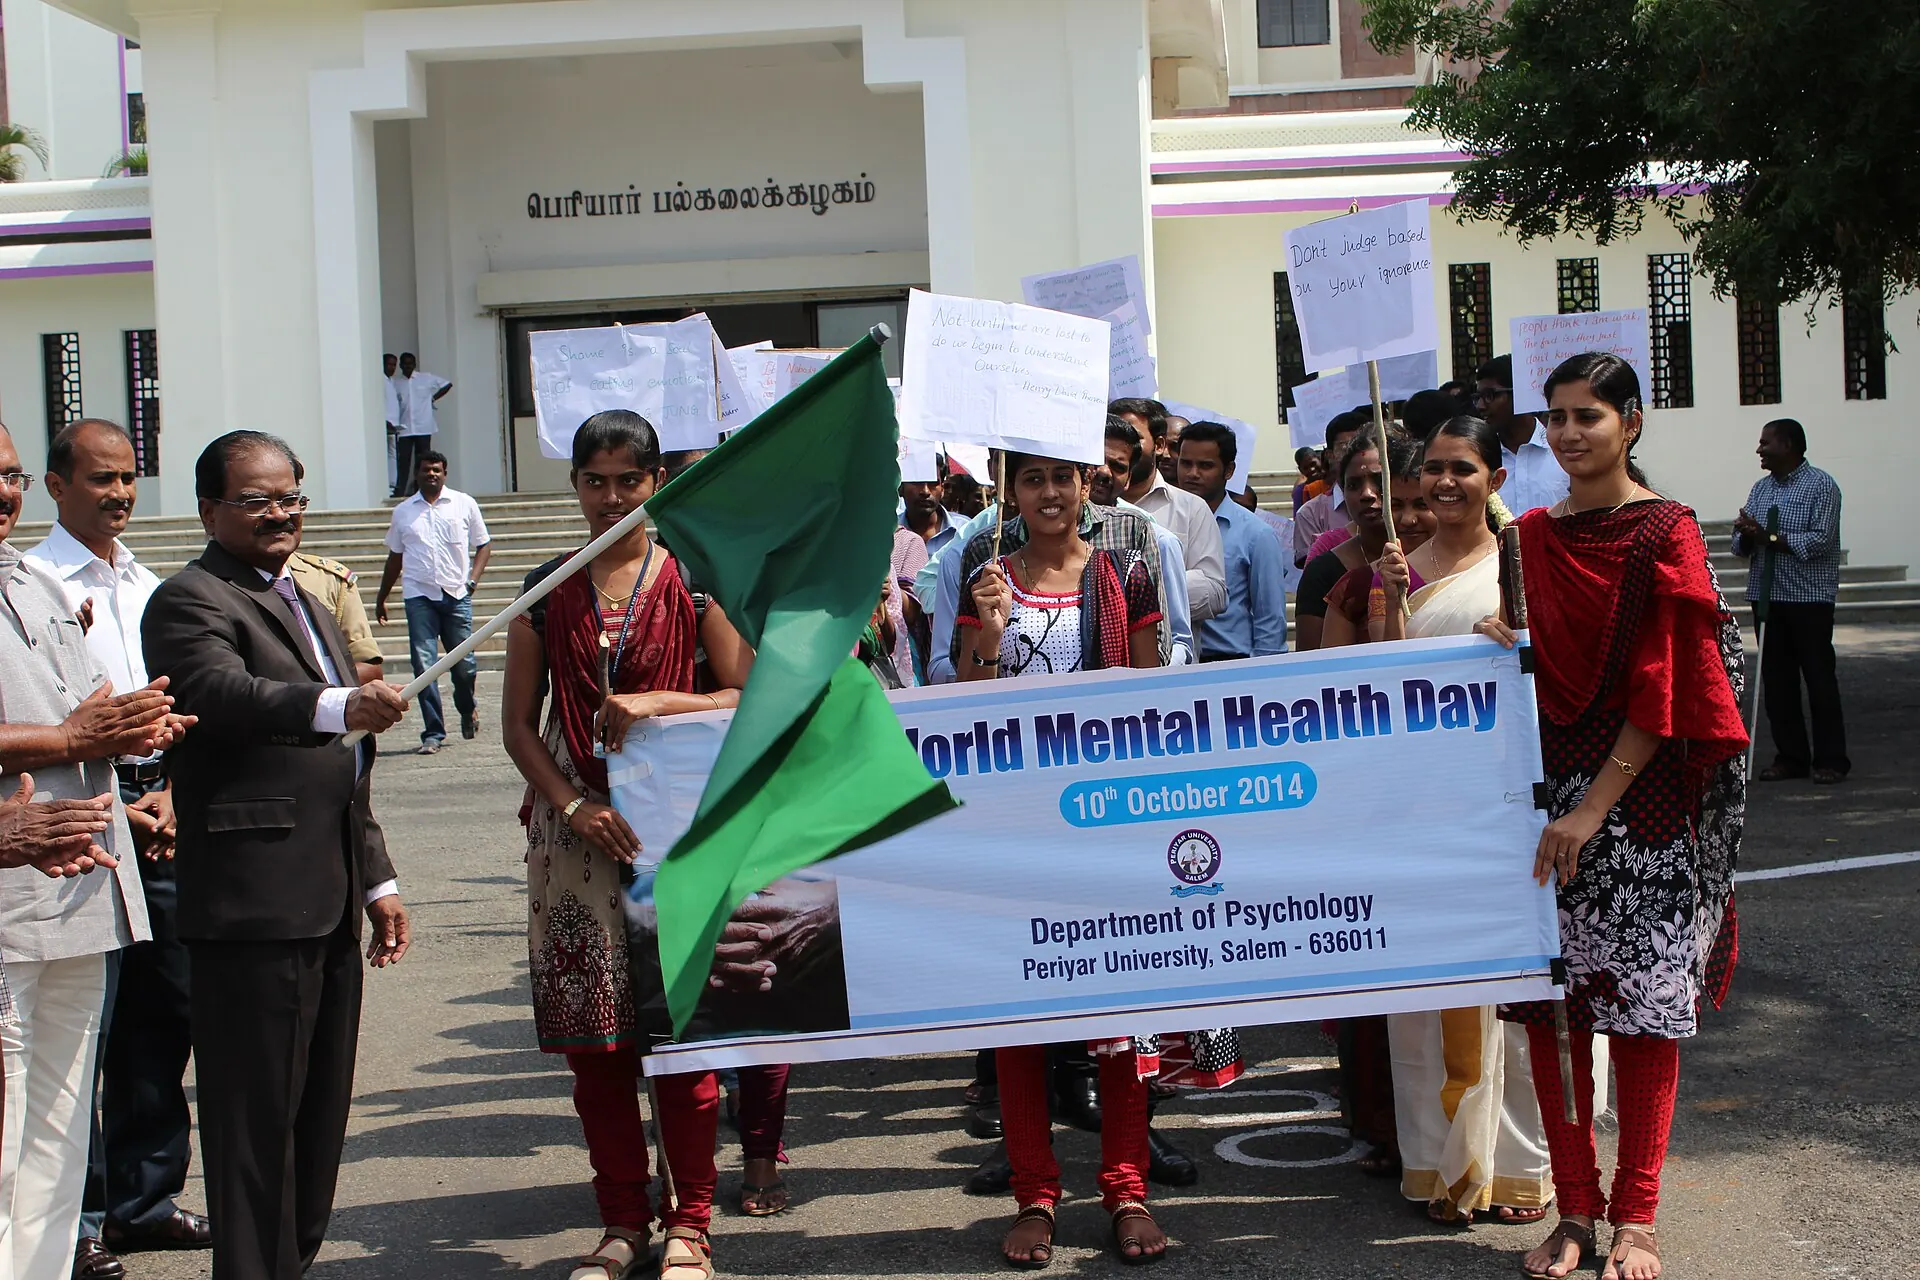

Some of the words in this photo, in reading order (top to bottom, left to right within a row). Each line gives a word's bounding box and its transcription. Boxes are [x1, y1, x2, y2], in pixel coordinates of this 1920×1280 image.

[527, 184, 641, 218] பெரியார்
[653, 172, 876, 216] பல்கலைக்கழகம்
[1290, 238, 1328, 268] Don't
[1340, 233, 1377, 256] judge
[1388, 227, 1427, 246] based
[1294, 282, 1312, 297] on
[932, 306, 962, 328] Not
[1010, 323, 1028, 332] we
[1032, 325, 1051, 336] are
[1055, 326, 1077, 340] lost
[1080, 331, 1092, 344] to
[1552, 318, 1580, 330] think
[559, 344, 605, 363] Shame
[932, 334, 947, 347] do
[952, 339, 968, 348] we
[971, 336, 1004, 355] begin
[1009, 340, 1020, 354] to
[1022, 380, 1052, 399] Henry
[660, 404, 699, 419] JUNG
[1034, 700, 1213, 769] Mental
[1222, 683, 1393, 750] Health
[1402, 678, 1498, 733] Day
[1073, 785, 1118, 820] 10th
[1127, 782, 1229, 816] October
[1237, 772, 1304, 806] 2014
[1170, 834, 1187, 865] PERIYAR
[1187, 832, 1219, 861] UNIVERSITY
[1184, 872, 1209, 882] SALEM
[1030, 906, 1184, 949] Department
[1191, 902, 1216, 931] of
[1225, 892, 1374, 931] Psychology
[1022, 955, 1097, 982] Periyar
[1104, 944, 1214, 975] University,
[1221, 938, 1287, 964] Salem
[1308, 927, 1388, 955] 636011
